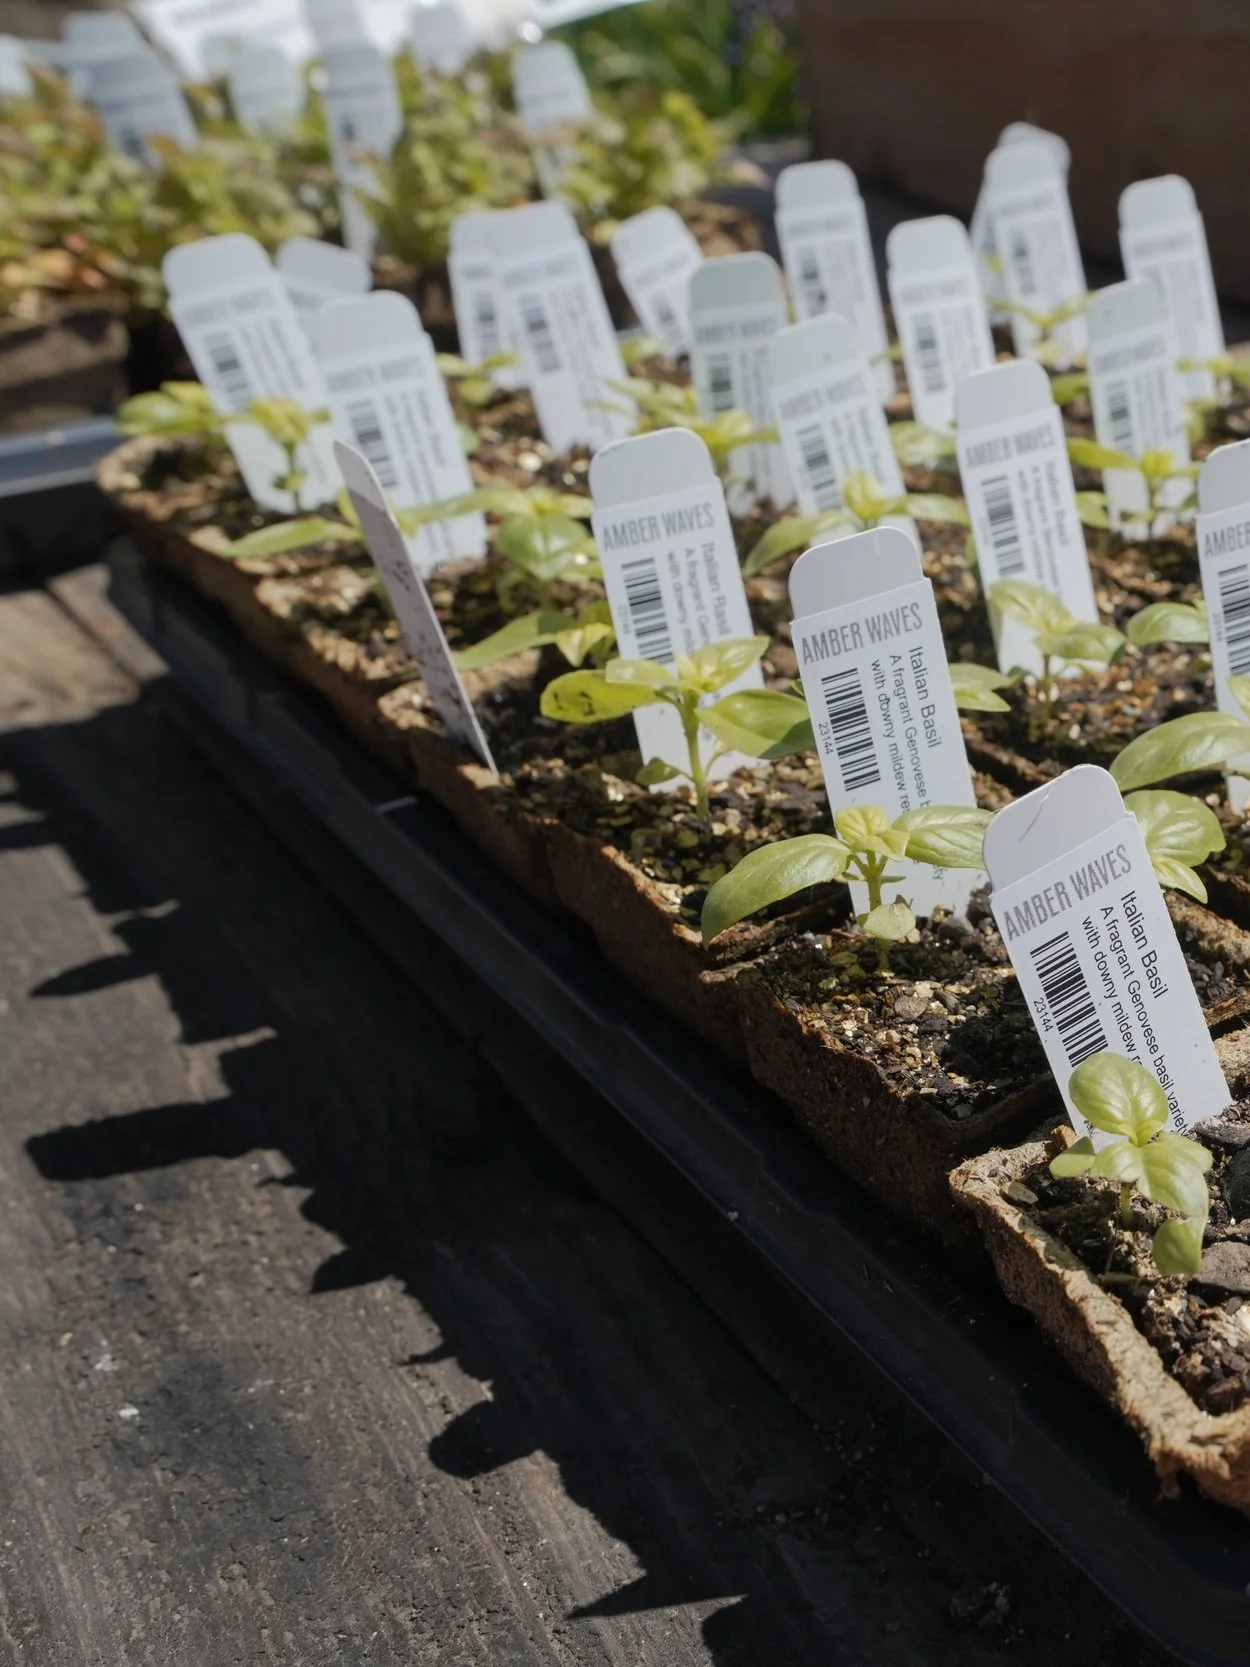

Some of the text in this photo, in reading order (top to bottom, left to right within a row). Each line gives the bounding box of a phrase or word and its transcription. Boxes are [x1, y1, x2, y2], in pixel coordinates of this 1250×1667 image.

[602, 501, 715, 553] AMBER WAVES
[801, 602, 923, 666] AMBER WAVES
[889, 654, 902, 666] A
[871, 659, 887, 690] with
[892, 667, 914, 724] fragrant
[909, 646, 942, 748] Italian Basil
[819, 721, 834, 754] 23144
[878, 693, 895, 739] downy
[888, 742, 906, 791] mildew
[905, 726, 927, 798] Genovese
[1003, 844, 1132, 941] AMBER WAVES
[1100, 906, 1114, 920] A
[1105, 919, 1135, 980] fragrant
[1120, 890, 1168, 999] Italian Basil
[1082, 916, 1101, 949] with
[1094, 950, 1118, 999] downy
[1111, 1002, 1136, 1053] mildew
[1033, 997, 1054, 1032] 23144
[1127, 980, 1159, 1055] Genovese
[1153, 1054, 1174, 1091] basil
